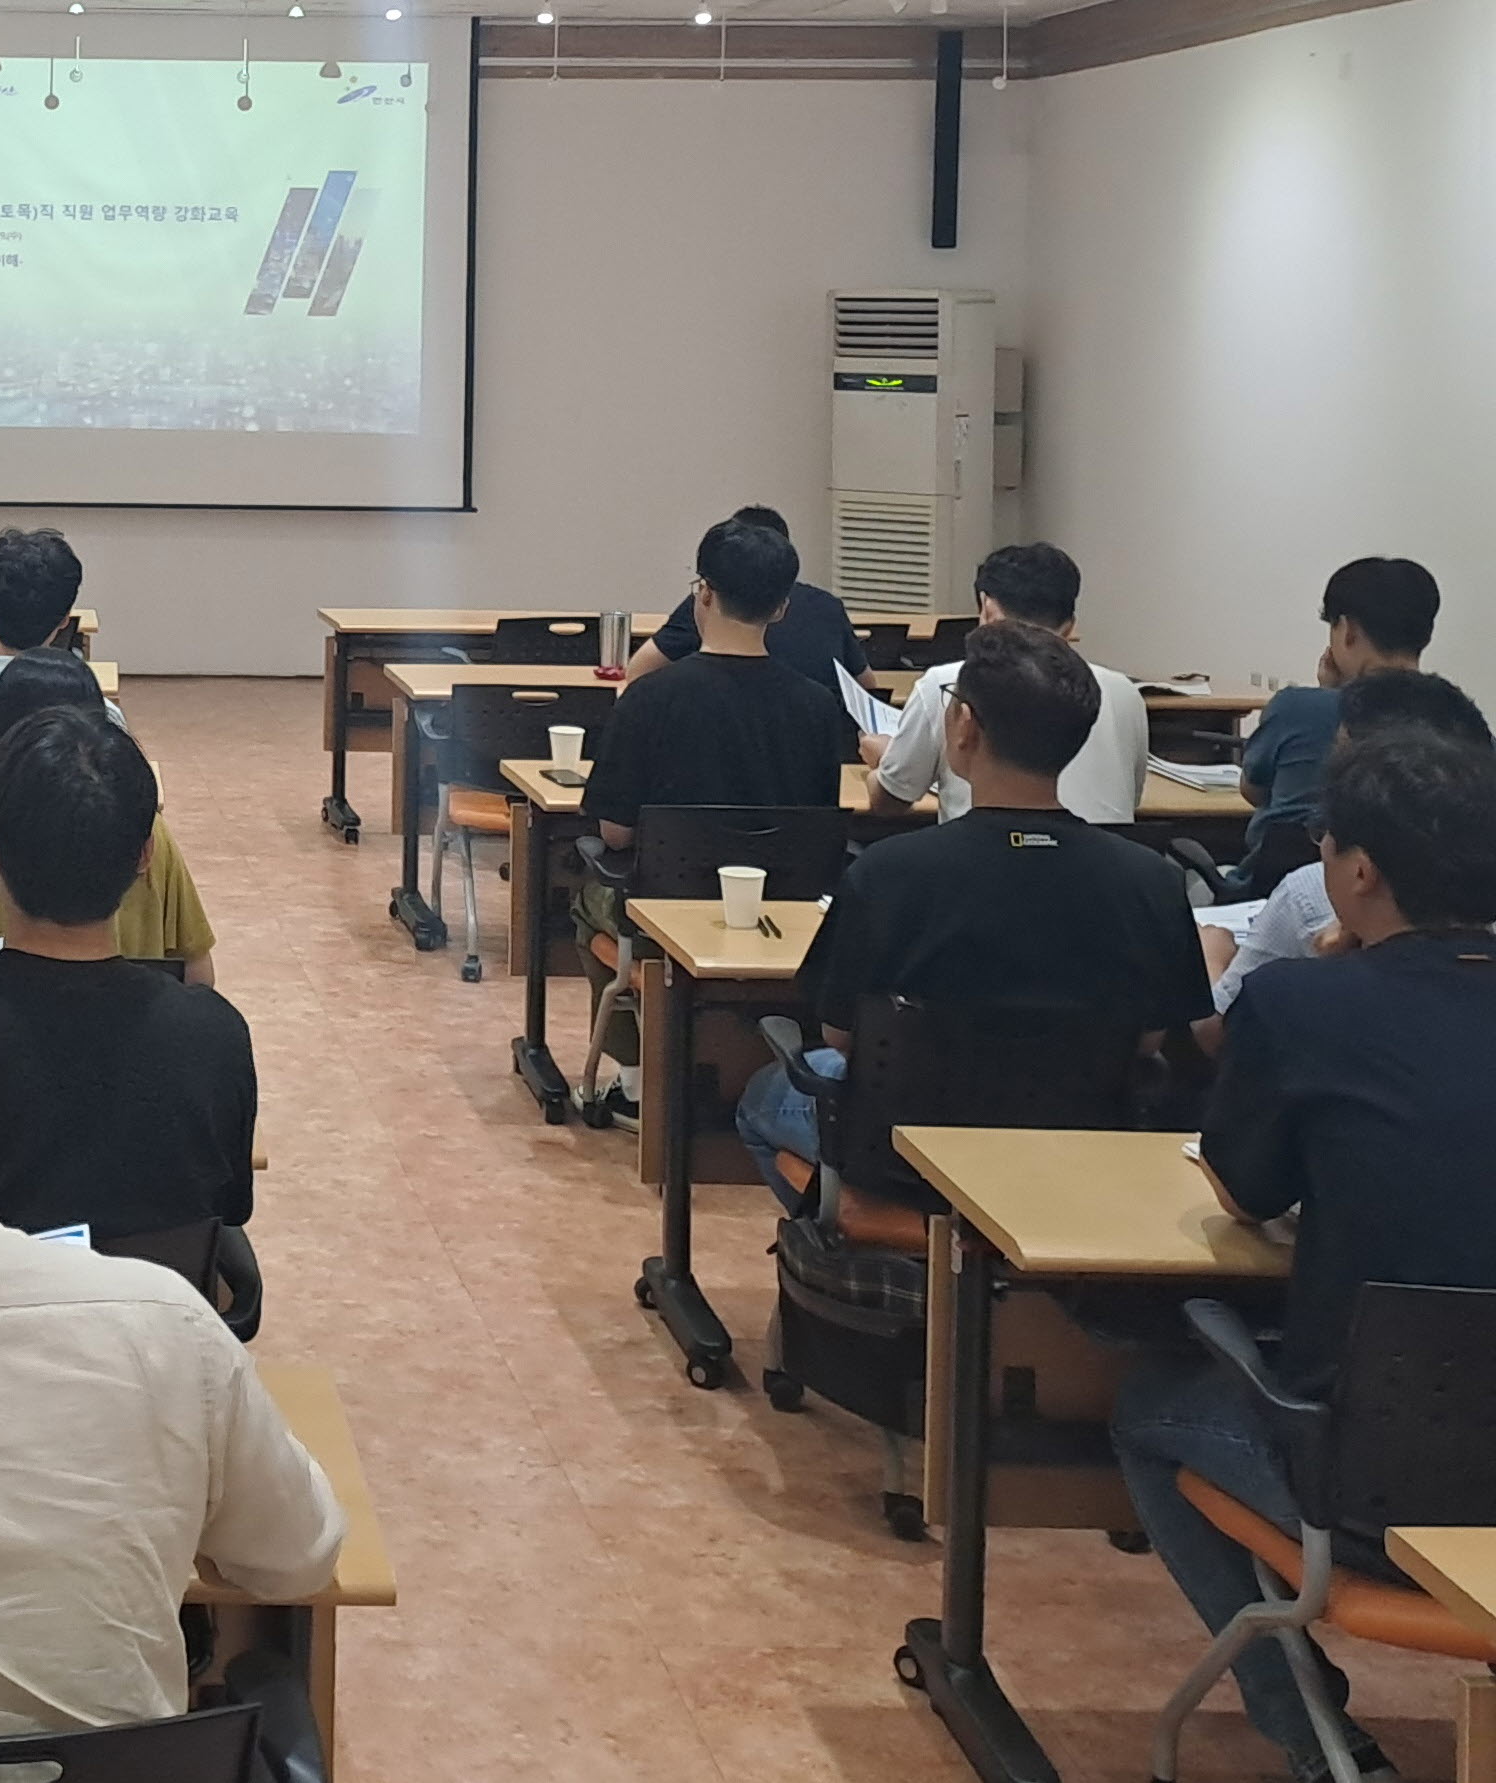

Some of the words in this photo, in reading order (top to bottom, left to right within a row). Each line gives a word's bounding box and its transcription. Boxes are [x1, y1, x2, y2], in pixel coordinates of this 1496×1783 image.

[62, 204, 94, 220] 직원
[101, 204, 167, 222] 업무역량
[174, 206, 239, 223] 강화교육
